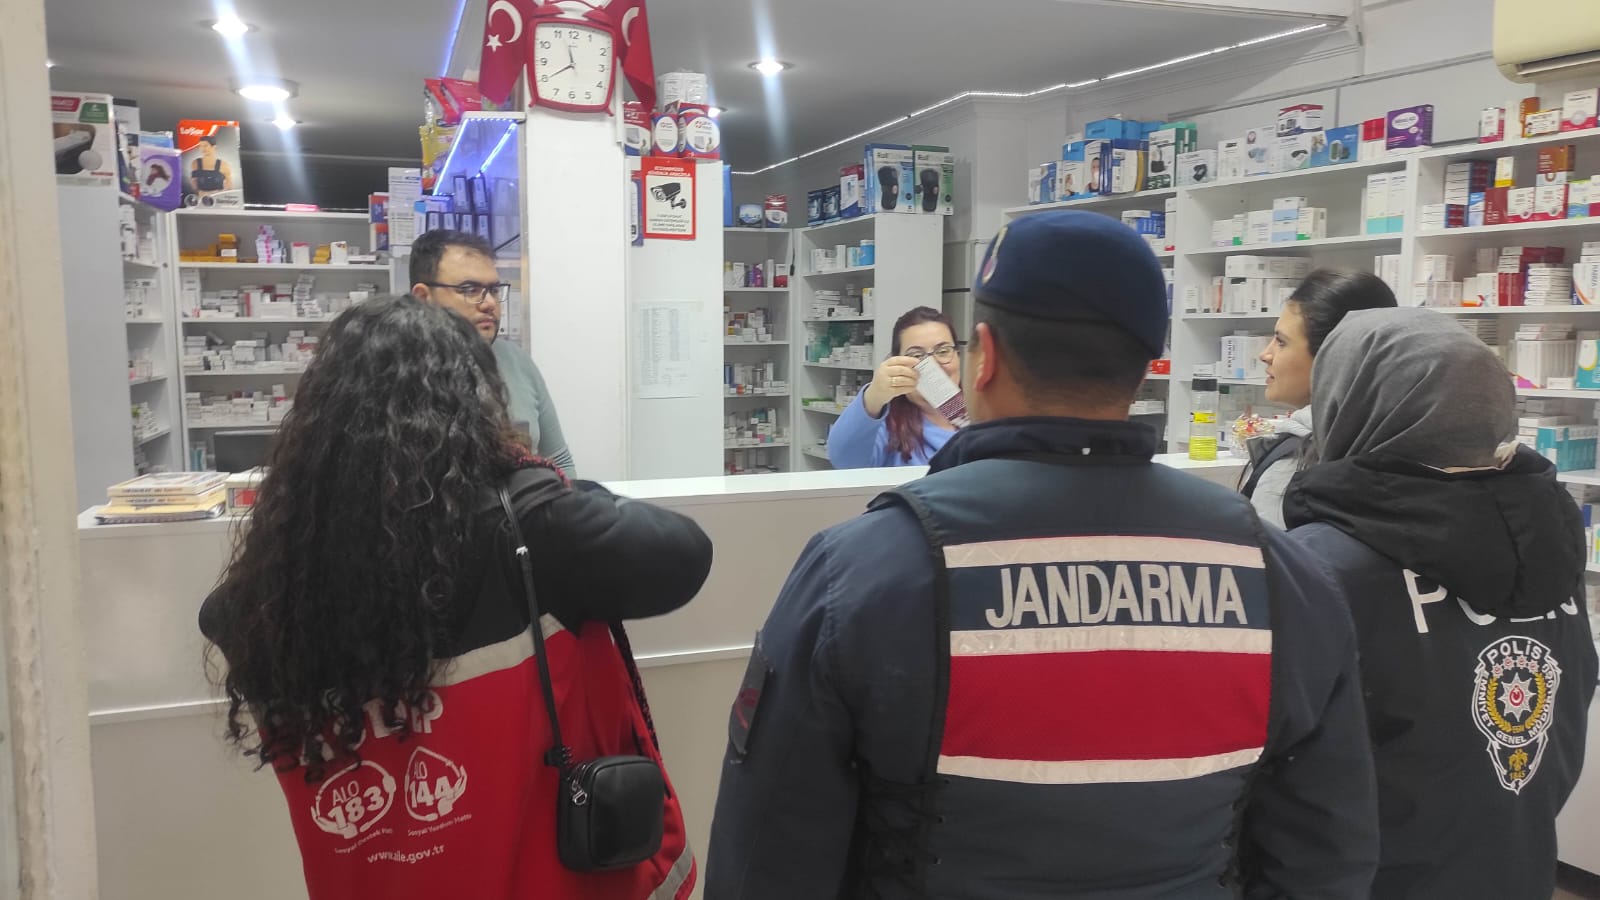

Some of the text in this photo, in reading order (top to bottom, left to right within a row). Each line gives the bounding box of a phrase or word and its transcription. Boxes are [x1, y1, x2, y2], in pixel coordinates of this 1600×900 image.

[553, 30, 562, 39] 11
[568, 30, 580, 40] 12
[540, 41, 551, 50] 10
[599, 47, 607, 57] 2
[540, 57, 548, 66] 9
[599, 64, 606, 73] 3
[541, 74, 549, 83] 8
[596, 80, 604, 89] 4
[552, 87, 560, 97] 7
[568, 90, 576, 100] 6
[584, 91, 592, 100] 5
[985, 563, 1248, 628] JANDARMA
[1486, 640, 1542, 665] POLİS
[1495, 730, 1527, 745] GENEL
[414, 761, 428, 780] ALO
[332, 780, 360, 806] ALO
[409, 775, 453, 809] 144
[327, 785, 385, 830] 183
